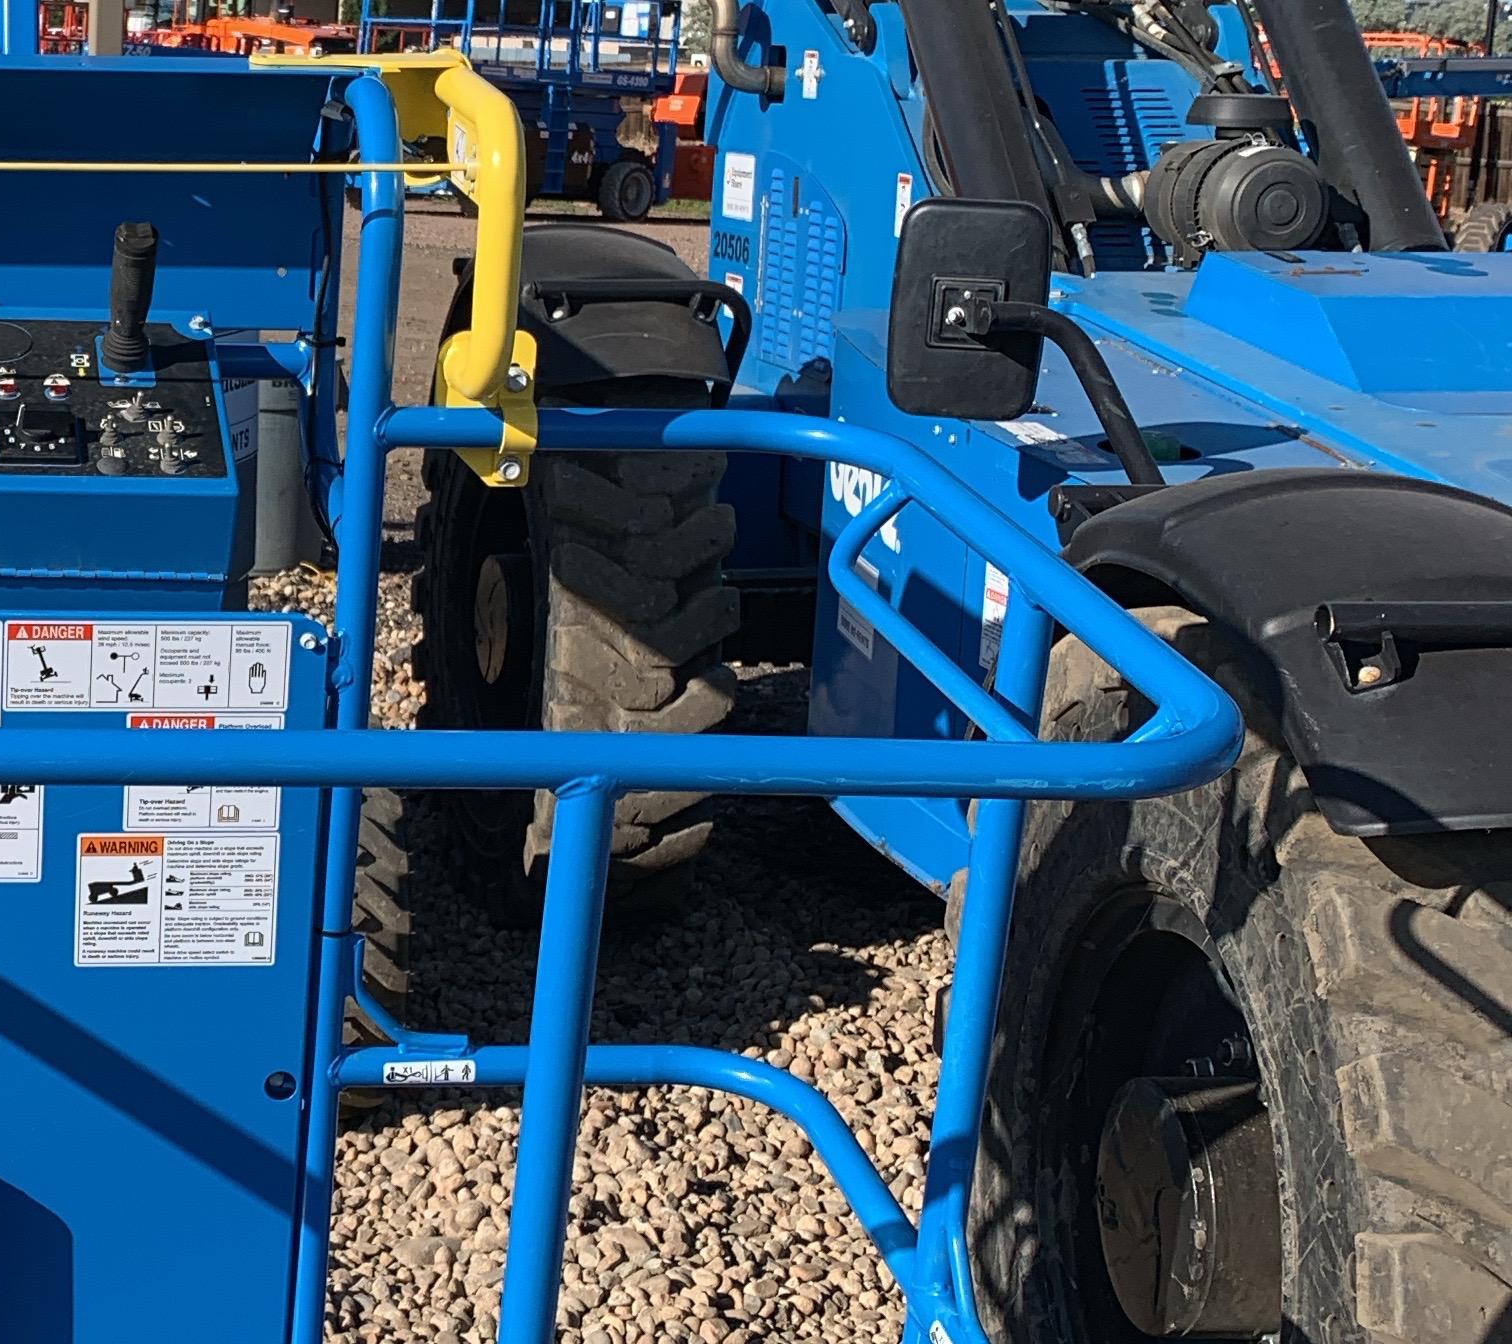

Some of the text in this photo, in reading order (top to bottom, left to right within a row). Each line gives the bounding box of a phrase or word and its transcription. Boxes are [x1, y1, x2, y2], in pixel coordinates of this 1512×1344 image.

[713, 231, 750, 265] 20506
[32, 626, 85, 639] DANGER
[152, 719, 207, 729] DANGER
[99, 841, 158, 854] WARNING
